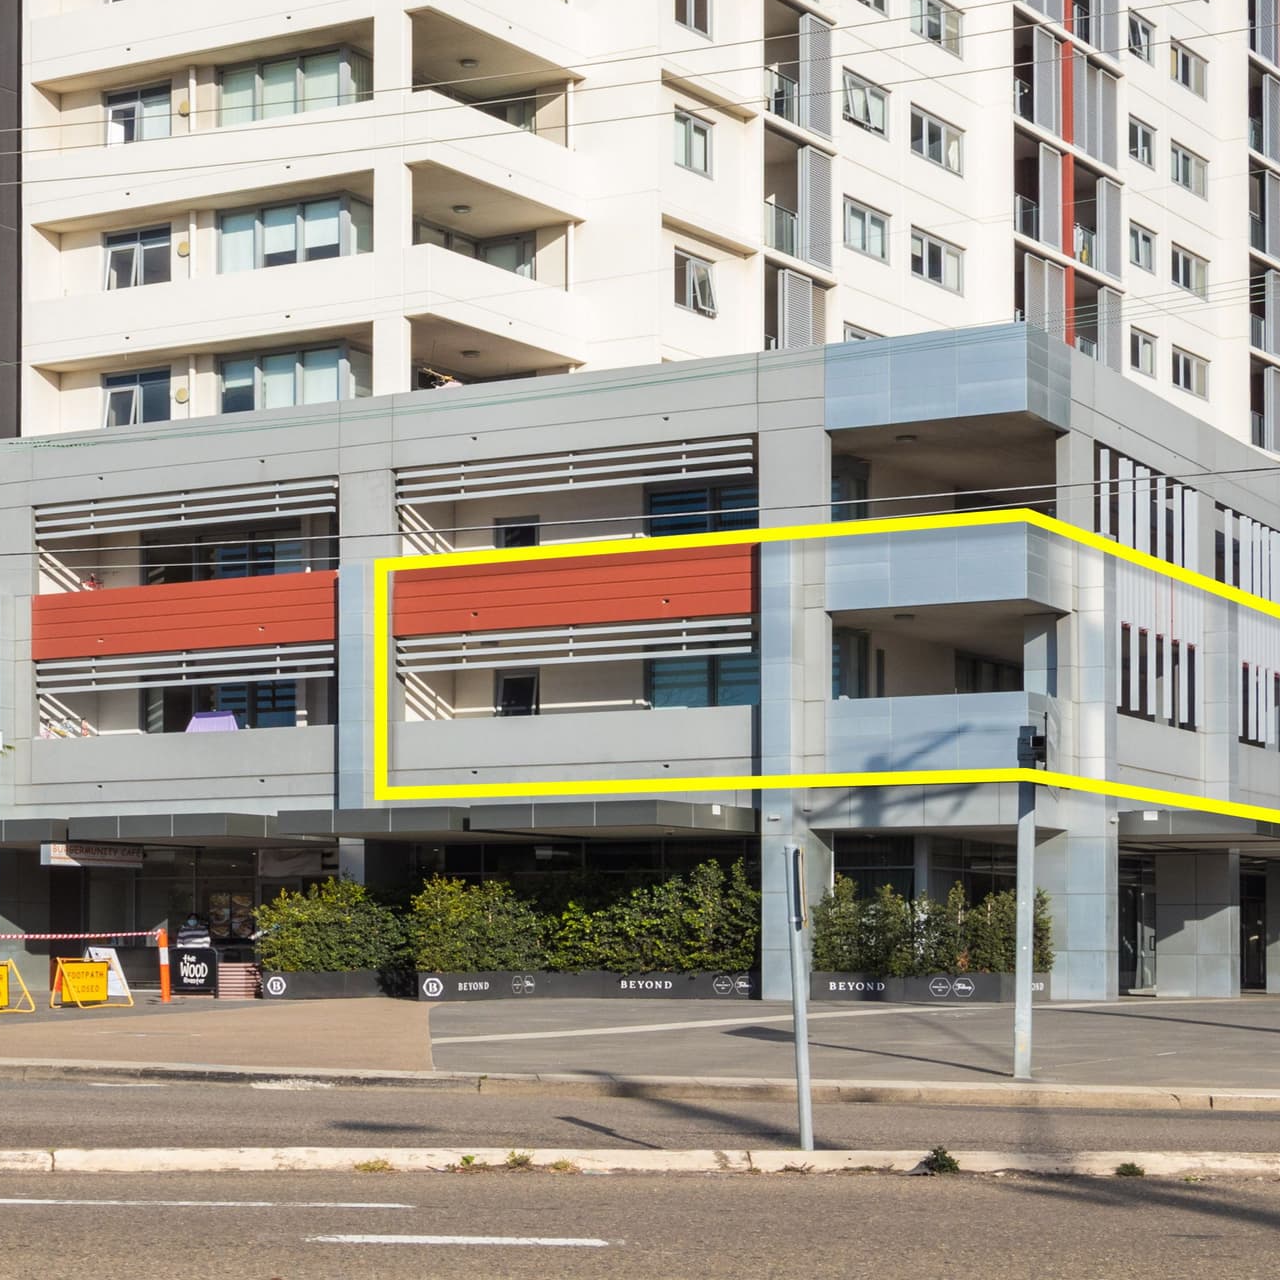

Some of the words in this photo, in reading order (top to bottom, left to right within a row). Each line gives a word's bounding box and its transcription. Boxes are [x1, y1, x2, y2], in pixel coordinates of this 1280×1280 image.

[180, 961, 208, 978] WOOD
[457, 980, 490, 992] BEYOND
[620, 979, 673, 990] BEYOND
[828, 981, 886, 991] BEYOND
